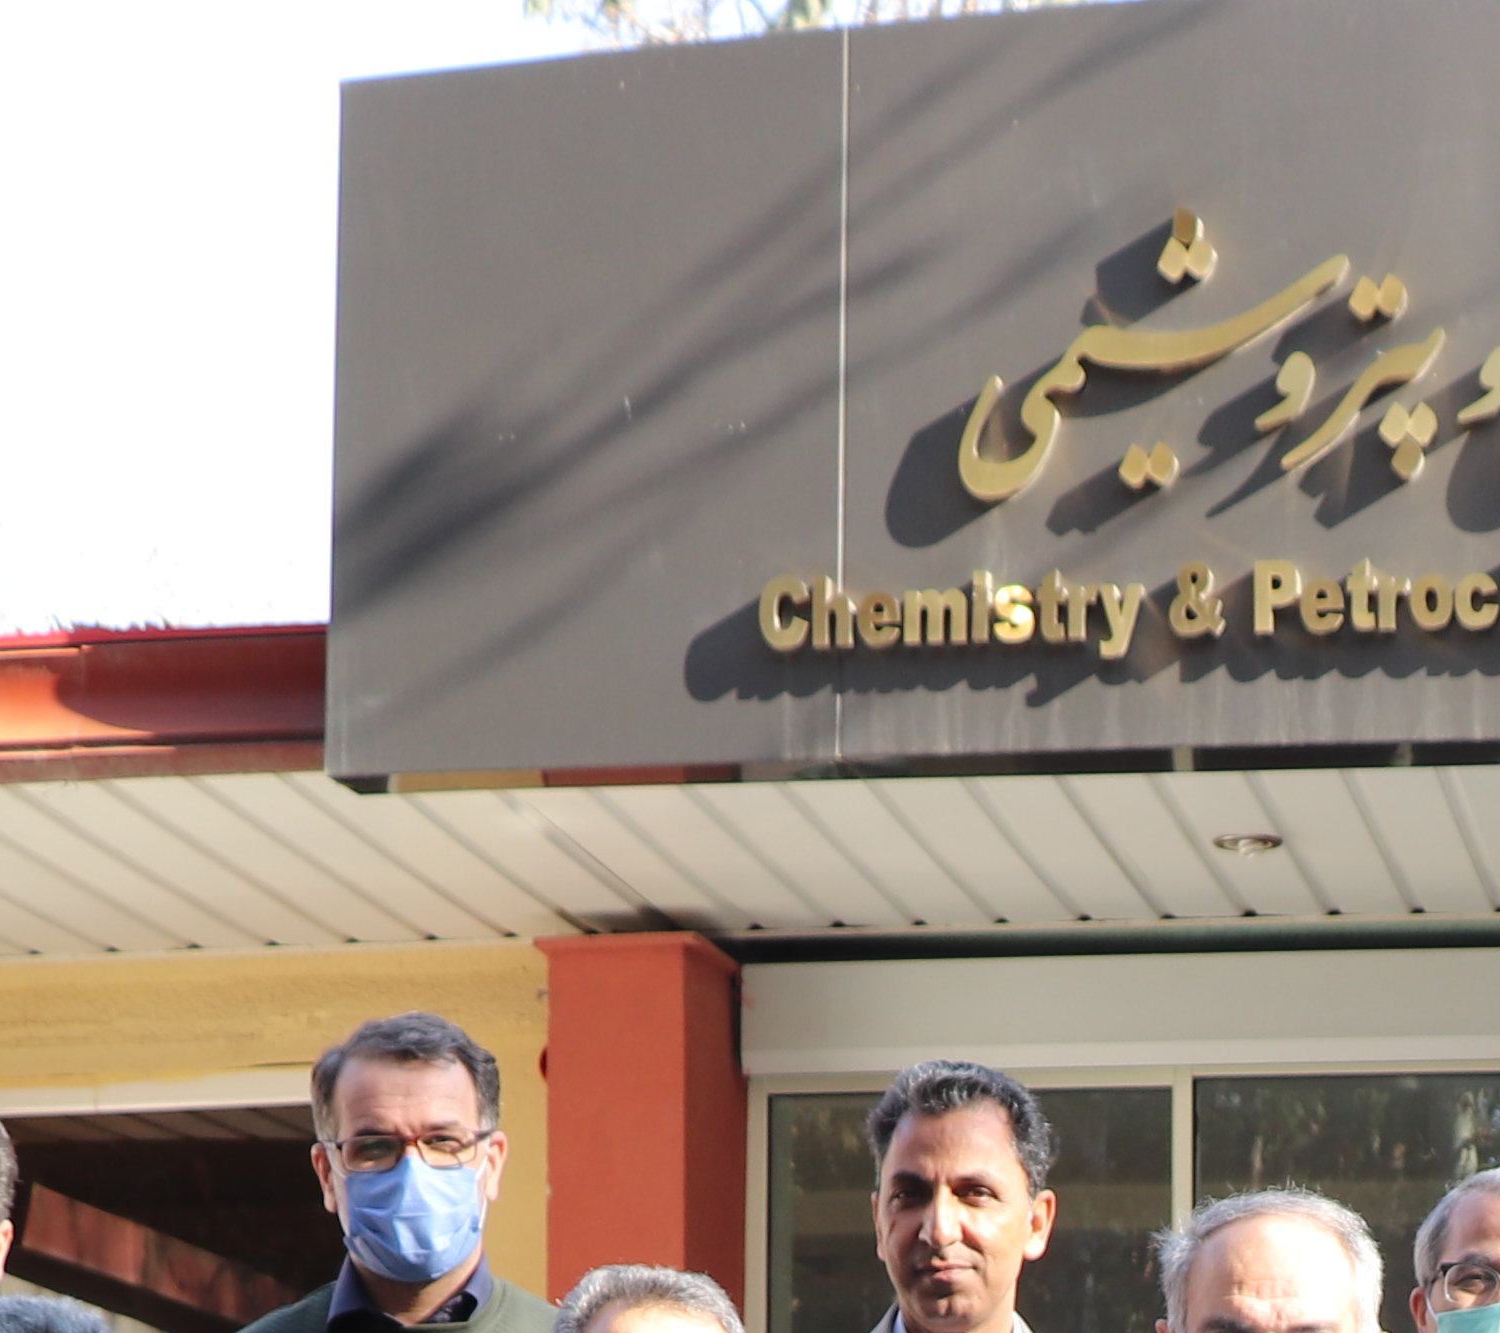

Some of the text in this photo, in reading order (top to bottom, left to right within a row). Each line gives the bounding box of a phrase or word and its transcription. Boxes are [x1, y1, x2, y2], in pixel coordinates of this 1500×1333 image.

[958, 206, 1448, 502] پتروشیمی
[758, 569, 1147, 661] Chemistry
[1169, 560, 1227, 640] &
